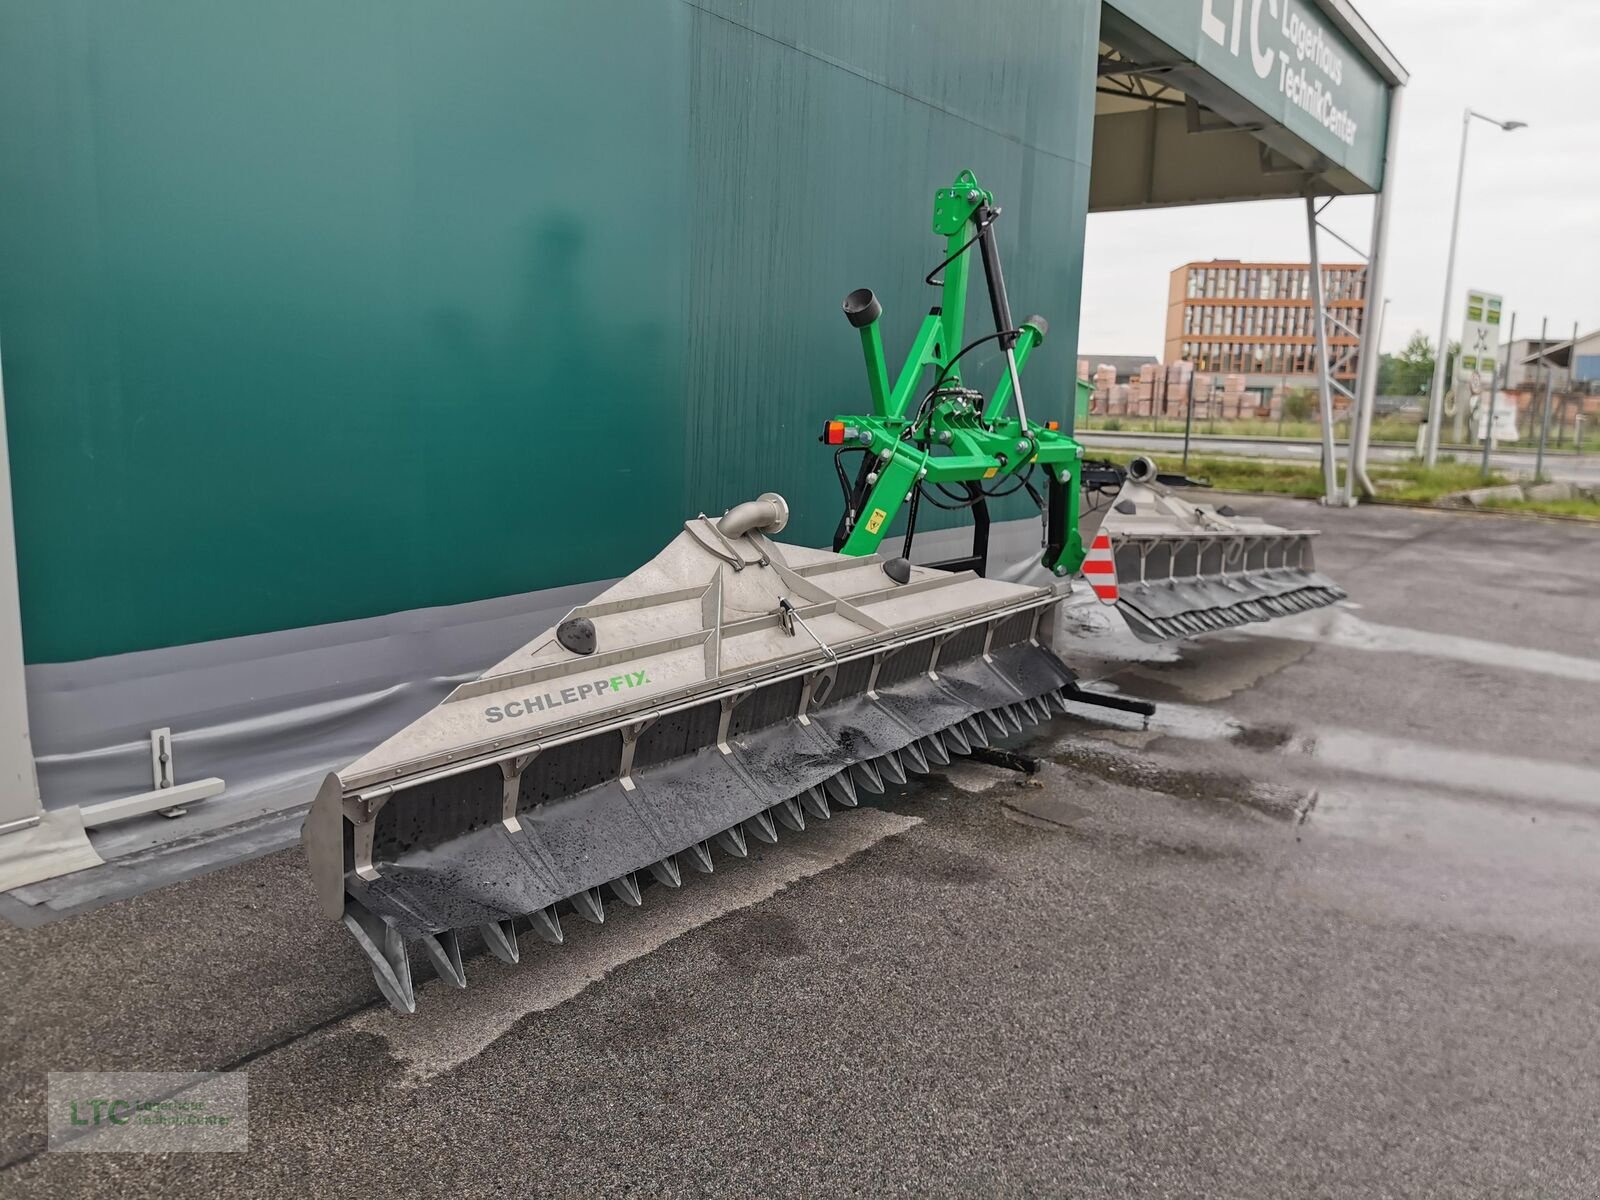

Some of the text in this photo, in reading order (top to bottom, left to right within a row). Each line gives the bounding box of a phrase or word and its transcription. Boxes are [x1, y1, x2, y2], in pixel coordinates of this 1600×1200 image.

[1281, 0, 1342, 86] Lagerhaus
[1279, 50, 1357, 146] TechnikCenter
[485, 670, 651, 723] SCHLEPPFIX
